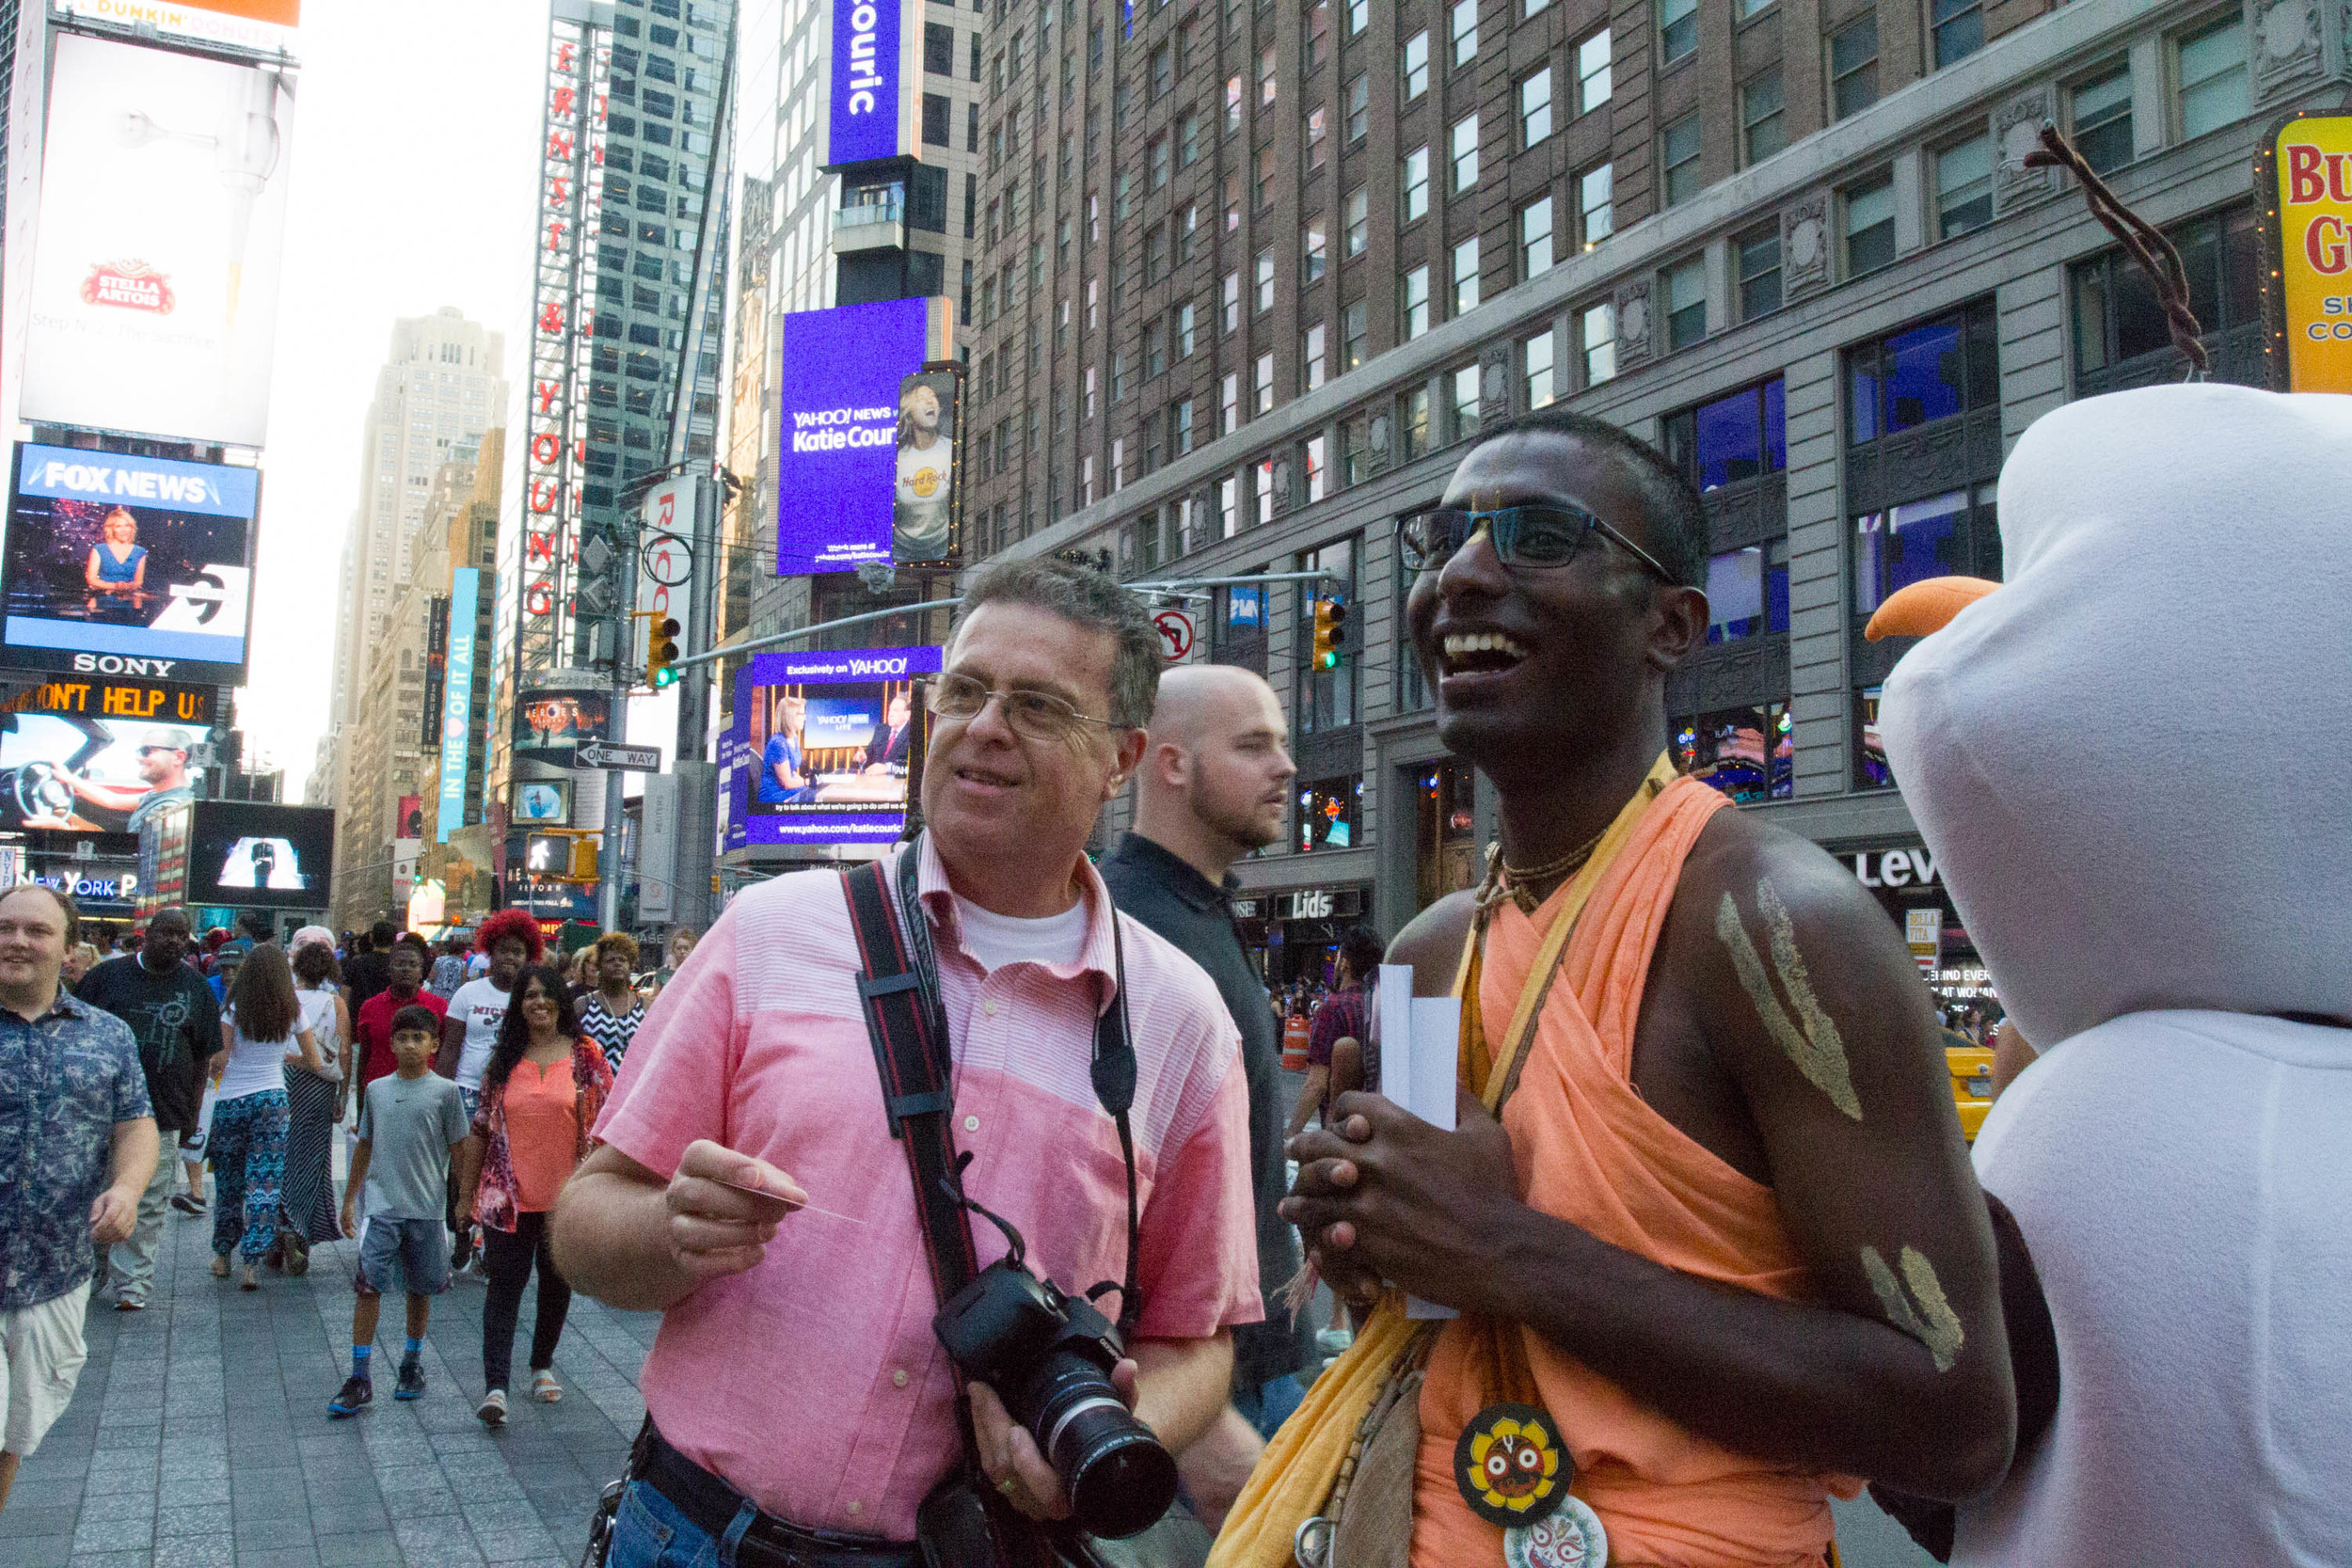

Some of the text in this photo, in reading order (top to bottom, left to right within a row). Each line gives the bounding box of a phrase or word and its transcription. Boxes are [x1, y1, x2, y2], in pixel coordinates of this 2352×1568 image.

[97, 0, 188, 26] DUNKIN'
[849, 0, 882, 115] ouric
[2305, 214, 2352, 276] G
[99, 276, 161, 294] STELLA
[97, 288, 160, 307] ARTOIS
[527, 43, 575, 615] ERNST & YOUNG
[793, 407, 852, 429] YAHOO!
[854, 407, 891, 421] NEWS
[793, 428, 846, 452] Katie
[45, 462, 207, 504] FOX NEWS
[73, 654, 177, 677] SONY
[787, 657, 908, 676] Exclusively on YAHOO!
[36, 683, 91, 712] ON'T
[103, 686, 167, 717] HELP
[444, 634, 470, 799] IN THE OF IT ALL
[588, 749, 654, 766] ONE WAY
[779, 823, 902, 835] www.yahoo.com/katiecouric
[63, 871, 115, 896] YORK
[1292, 890, 1334, 919] Lids
[1923, 970, 1962, 981] EHIND
